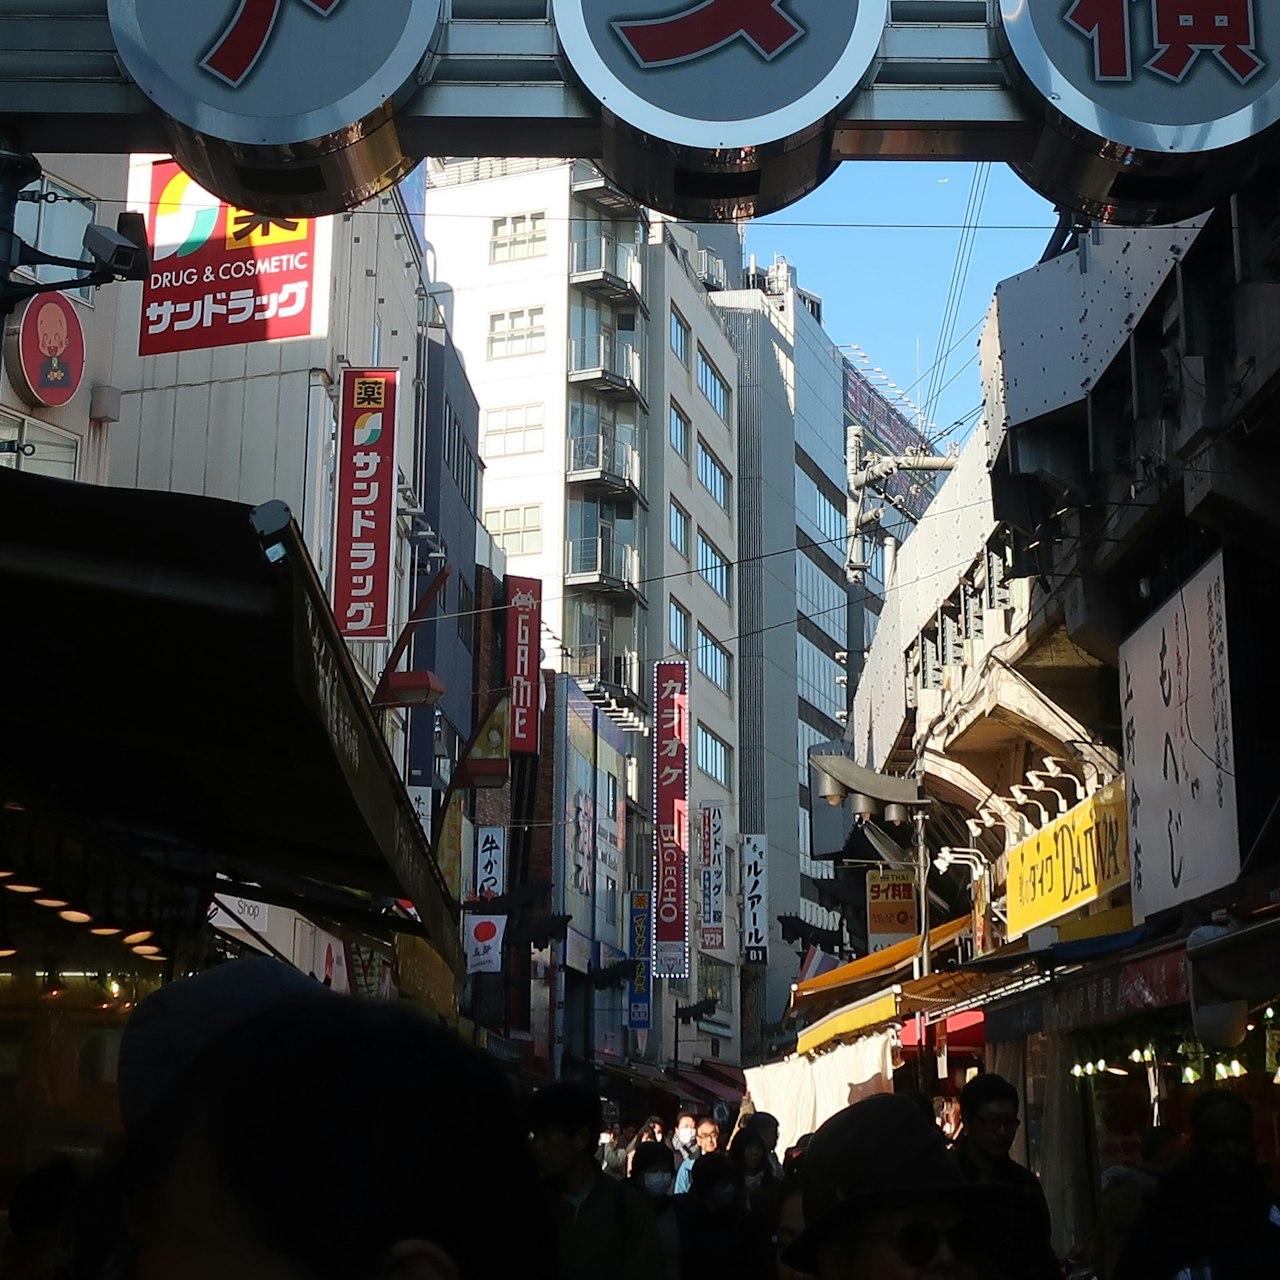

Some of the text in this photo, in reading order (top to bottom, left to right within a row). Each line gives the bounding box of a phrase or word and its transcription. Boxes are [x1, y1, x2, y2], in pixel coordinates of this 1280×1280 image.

[150, 251, 308, 289] DRUG & COSMETIC
[146, 280, 309, 335] サンドラッグ
[356, 380, 382, 406] 薬
[346, 451, 381, 631] サンドラッグ
[512, 613, 531, 739] GAME
[660, 679, 683, 787] カラオケ
[1160, 627, 1183, 889] もへじ
[481, 834, 500, 895] 牛かつ
[1029, 854, 1054, 902] ダイワ
[1058, 813, 1120, 903] DAIWA
[747, 860, 764, 945] ルノアール
[871, 882, 913, 900] タイ料理
[749, 949, 763, 961] B1
